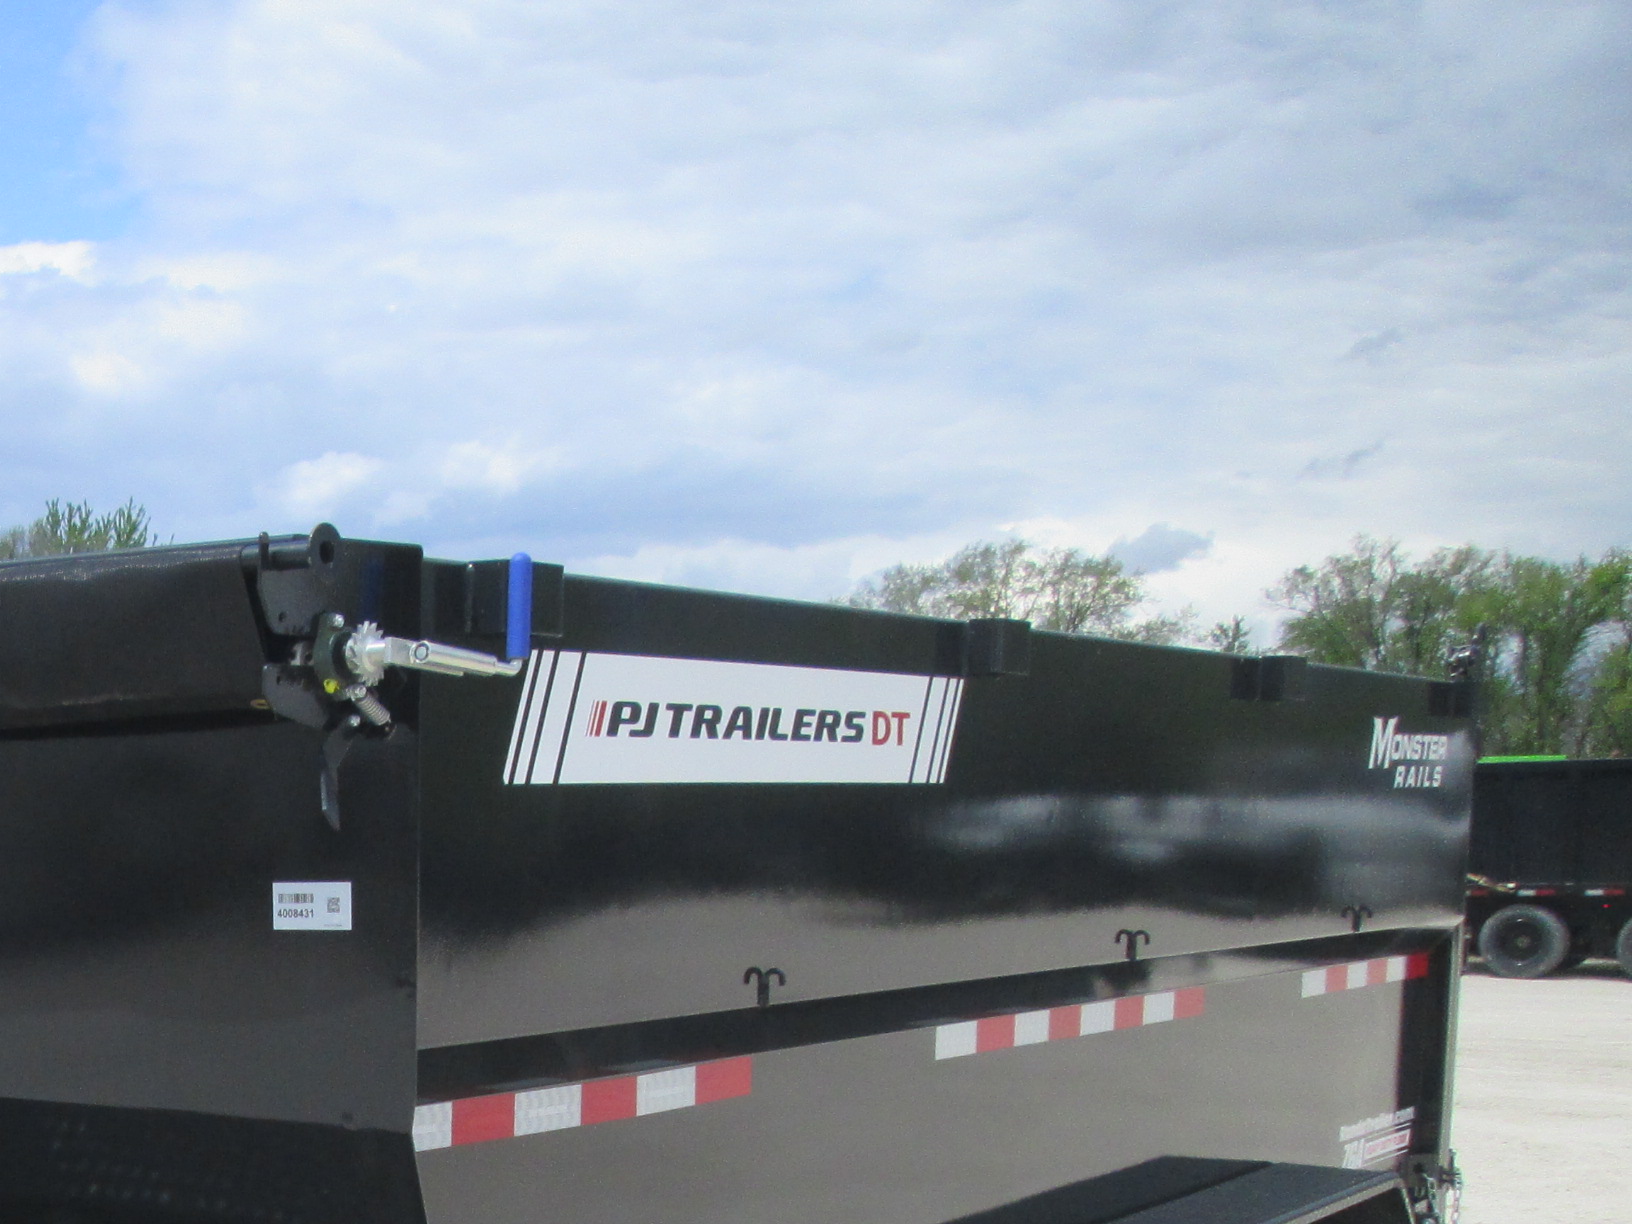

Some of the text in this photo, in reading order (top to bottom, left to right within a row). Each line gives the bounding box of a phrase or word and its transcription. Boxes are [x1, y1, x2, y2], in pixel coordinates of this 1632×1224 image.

[606, 700, 911, 746] PJ TRAILERS DT
[1394, 765, 1443, 788] RAILS
[277, 908, 314, 918] 4008431
